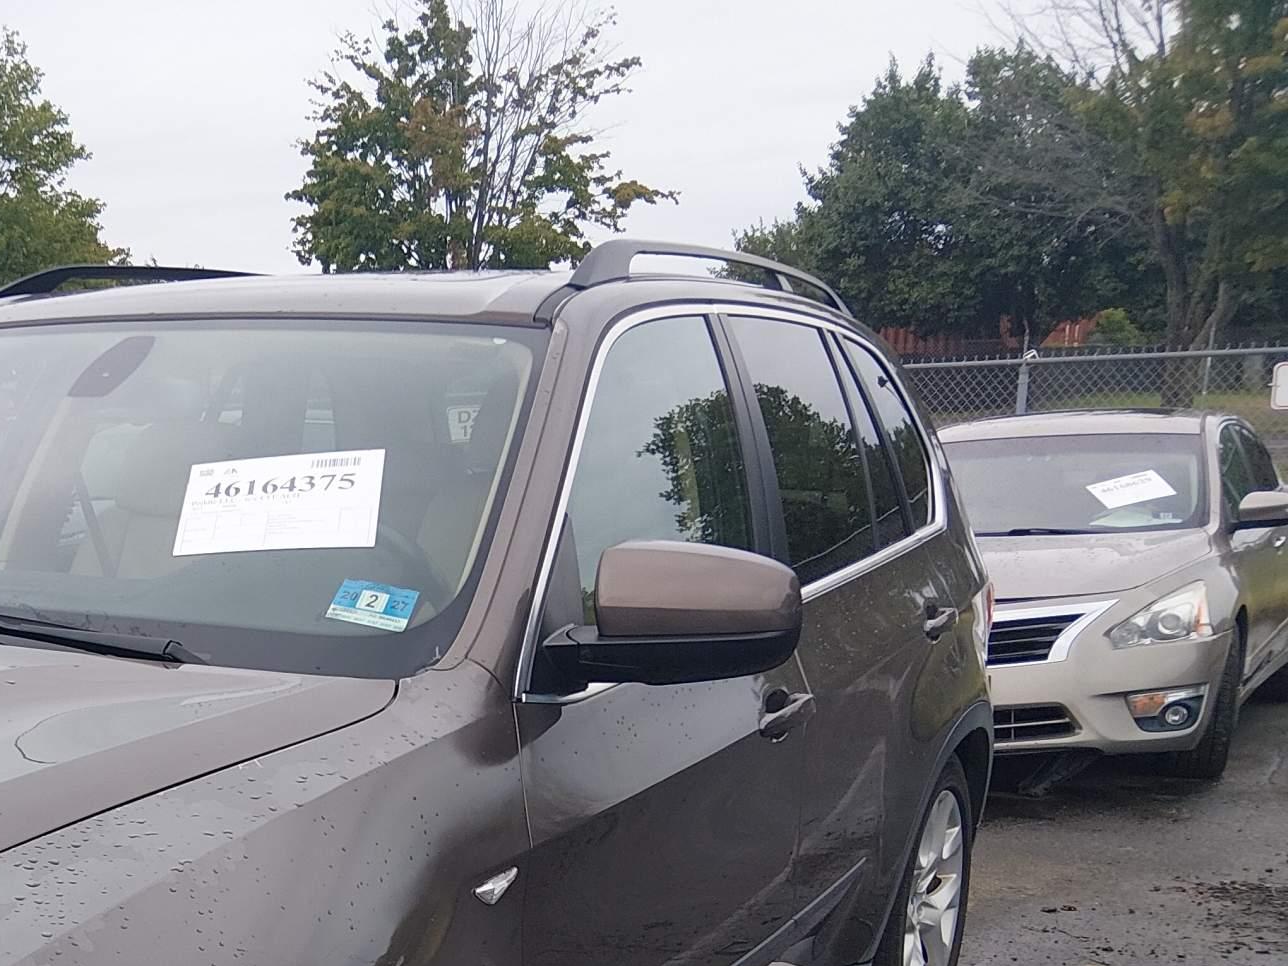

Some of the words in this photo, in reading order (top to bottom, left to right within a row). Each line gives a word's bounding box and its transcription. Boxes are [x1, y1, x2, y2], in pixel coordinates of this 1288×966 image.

[457, 409, 478, 424] D
[205, 472, 357, 498] 46164375
[365, 594, 379, 608] 2
